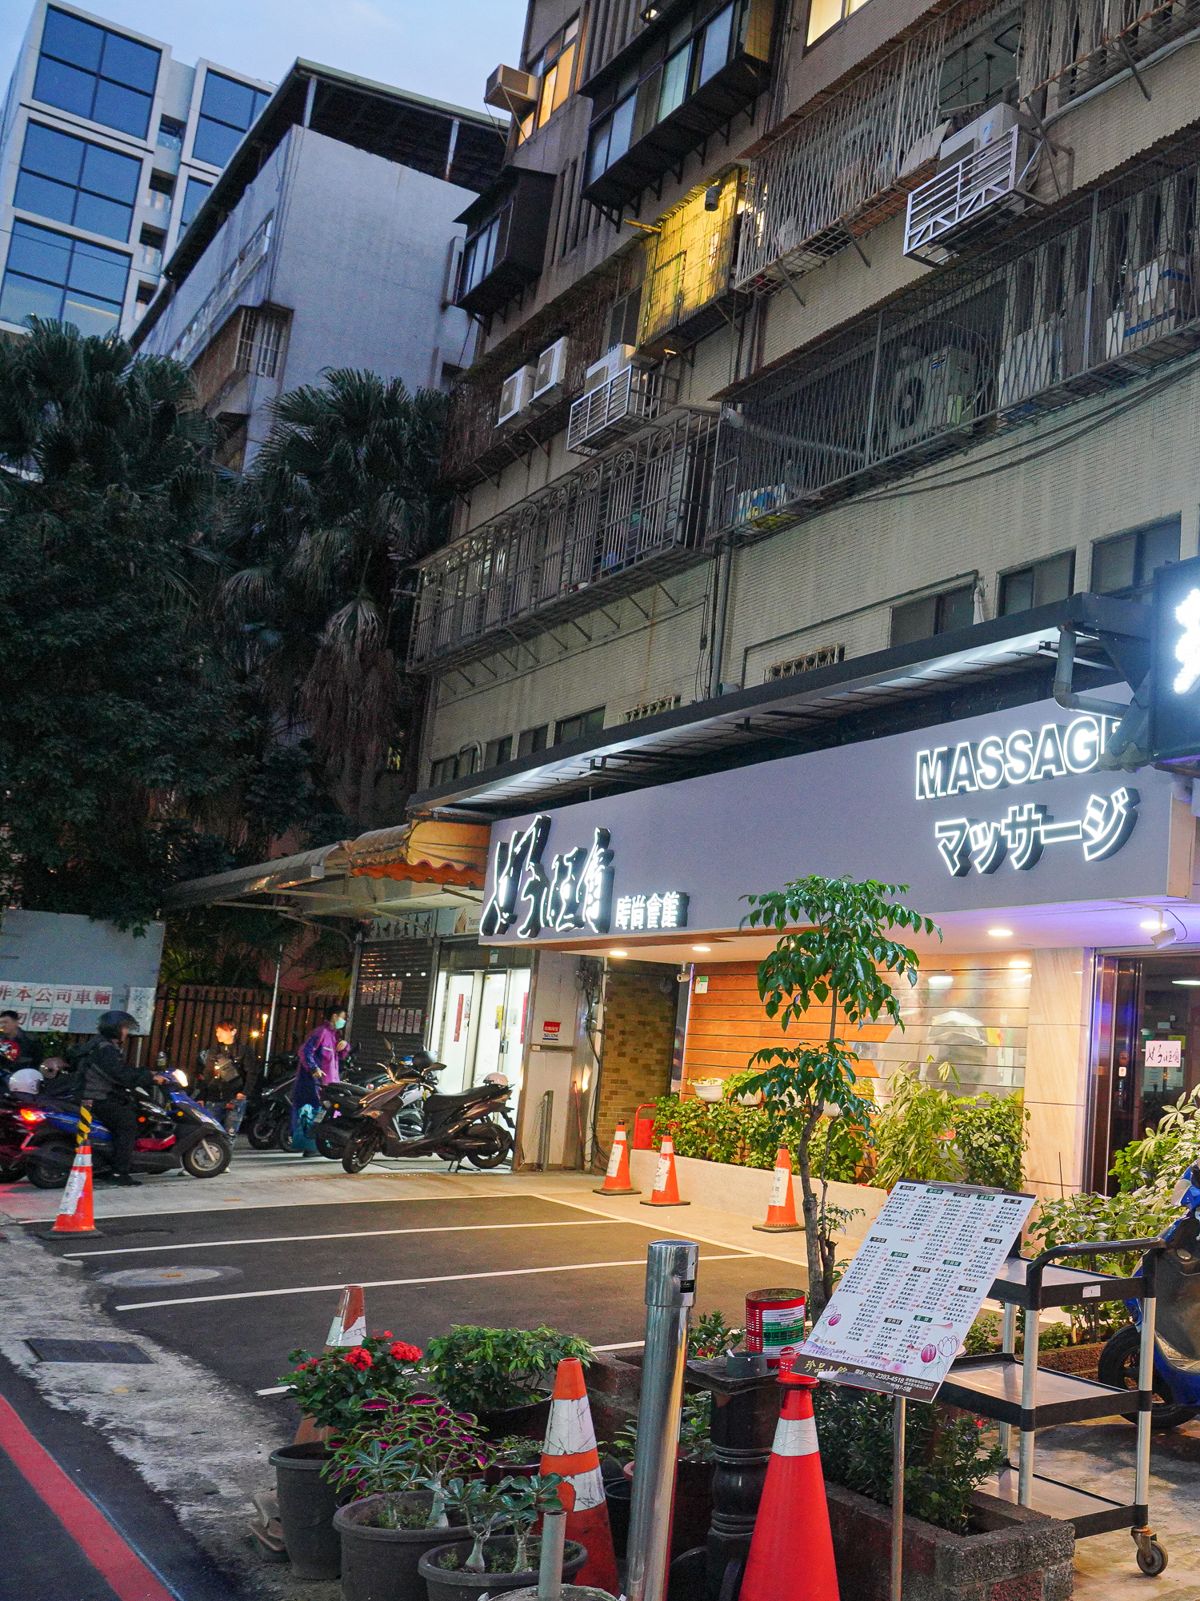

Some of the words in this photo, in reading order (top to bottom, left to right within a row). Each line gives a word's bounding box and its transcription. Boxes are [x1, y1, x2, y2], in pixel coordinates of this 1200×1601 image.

[934, 786, 1131, 877] マッサージ
